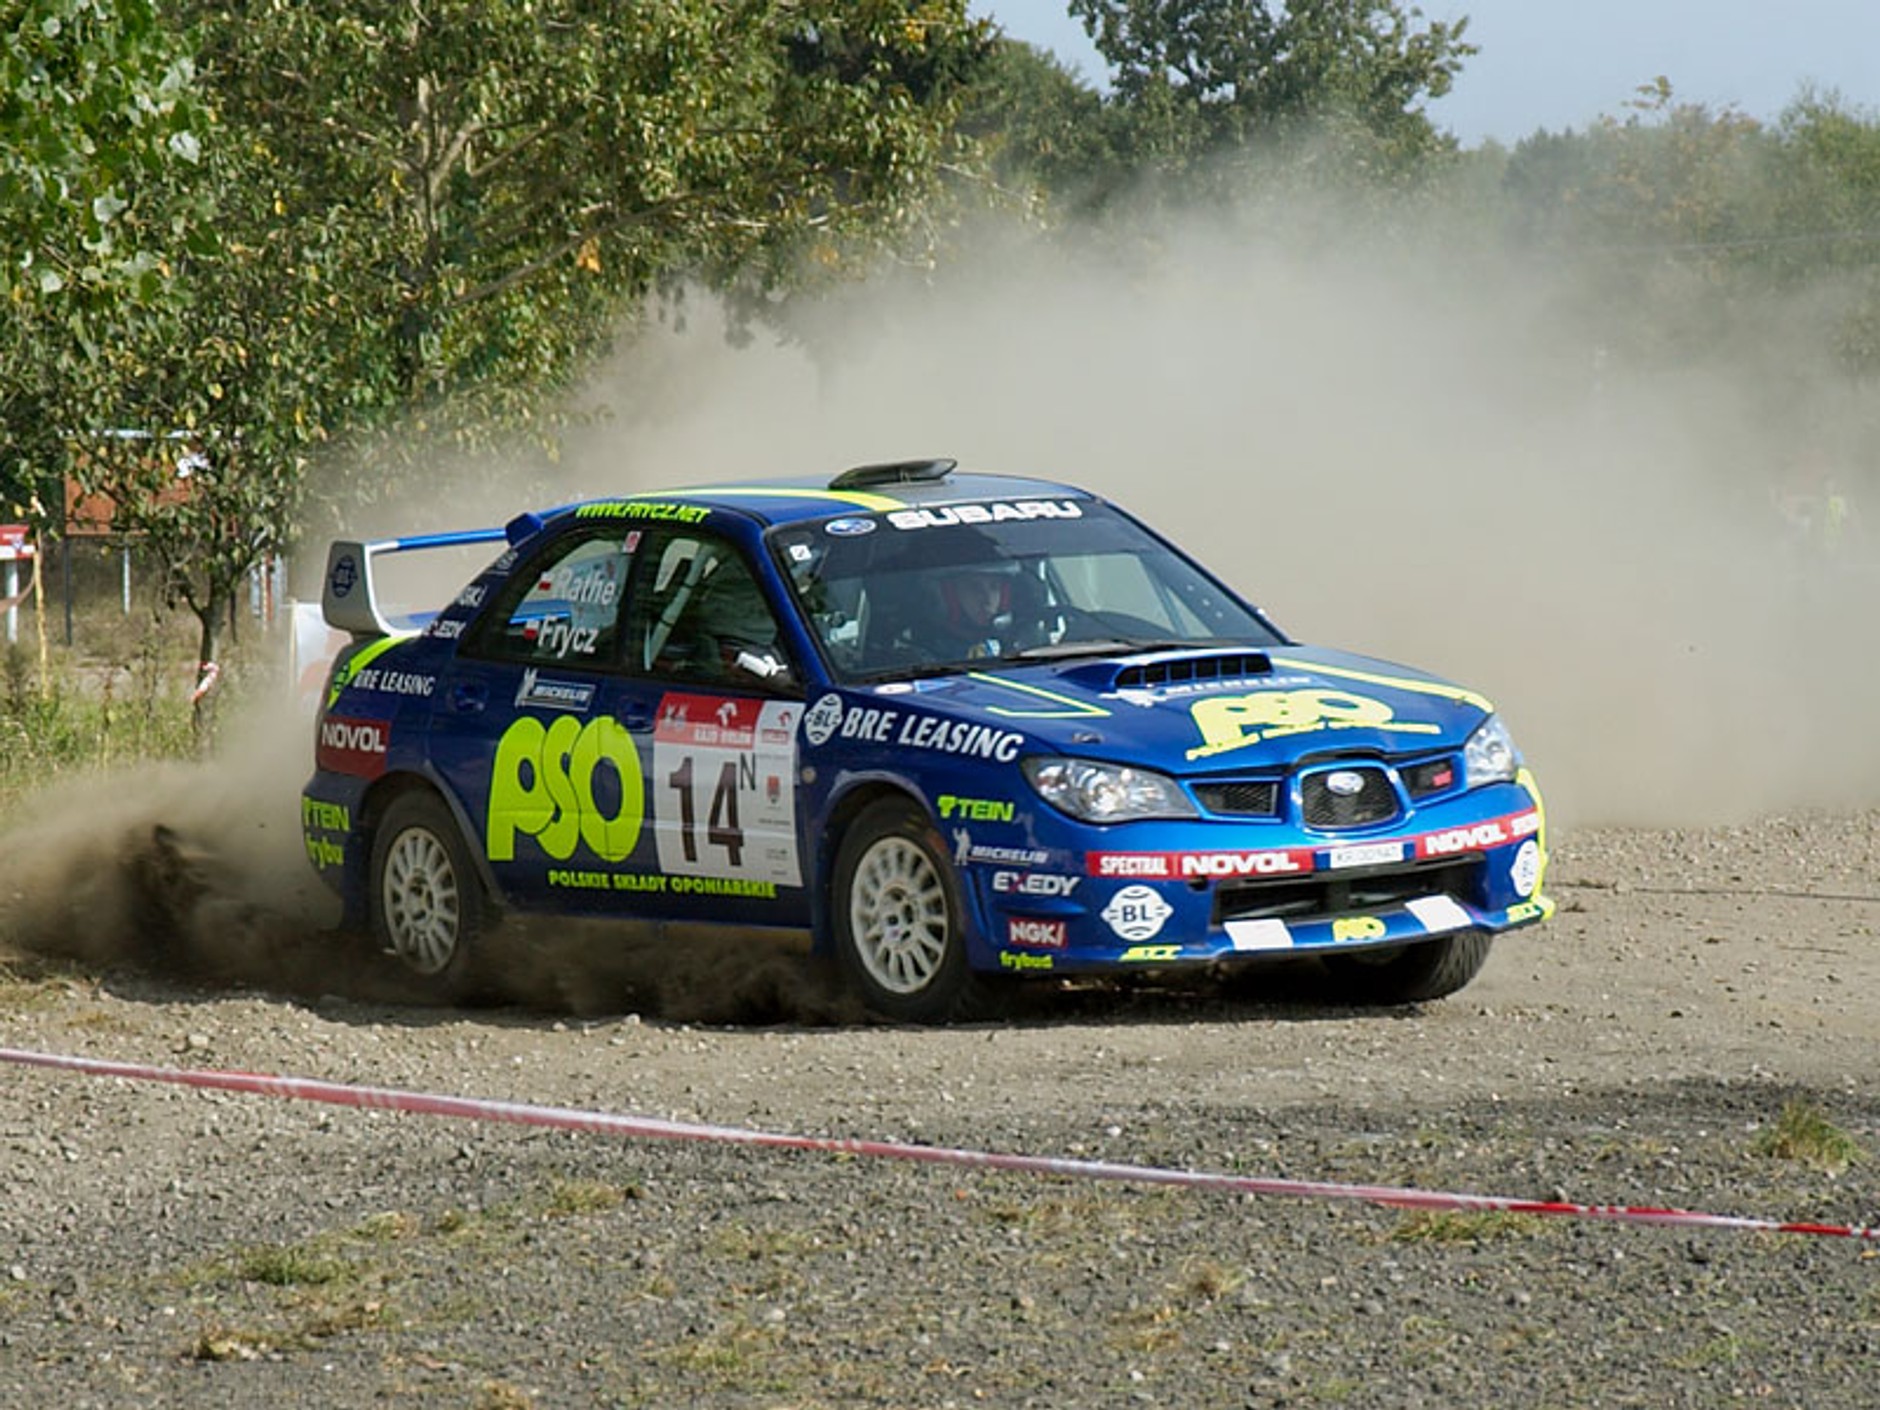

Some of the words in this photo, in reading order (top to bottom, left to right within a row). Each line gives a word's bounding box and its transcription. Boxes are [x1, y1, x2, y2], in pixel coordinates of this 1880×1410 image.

[887, 500, 1082, 530] SUBARU
[555, 565, 616, 605] Rathe
[538, 615, 599, 659] Frycz
[381, 670, 436, 696] LEASING
[322, 722, 387, 753] NOVOL
[813, 709, 833, 728] BL
[841, 707, 898, 741] BRE
[898, 714, 1024, 763] LEASING
[486, 715, 645, 861] PSO
[312, 801, 350, 832] TEIN
[669, 757, 744, 866] 14
[740, 753, 756, 791] N
[959, 799, 1014, 821] TEIN
[1424, 823, 1507, 854] NOVOL
[971, 846, 1048, 864] MICHELIN
[1100, 856, 1168, 876] SPECTRAL
[1182, 852, 1299, 875] NOVOL
[548, 870, 610, 889] POLSKIE
[670, 877, 778, 899] OPONIARSKIE
[993, 871, 1080, 896] EXEDY
[1122, 904, 1153, 922] BL
